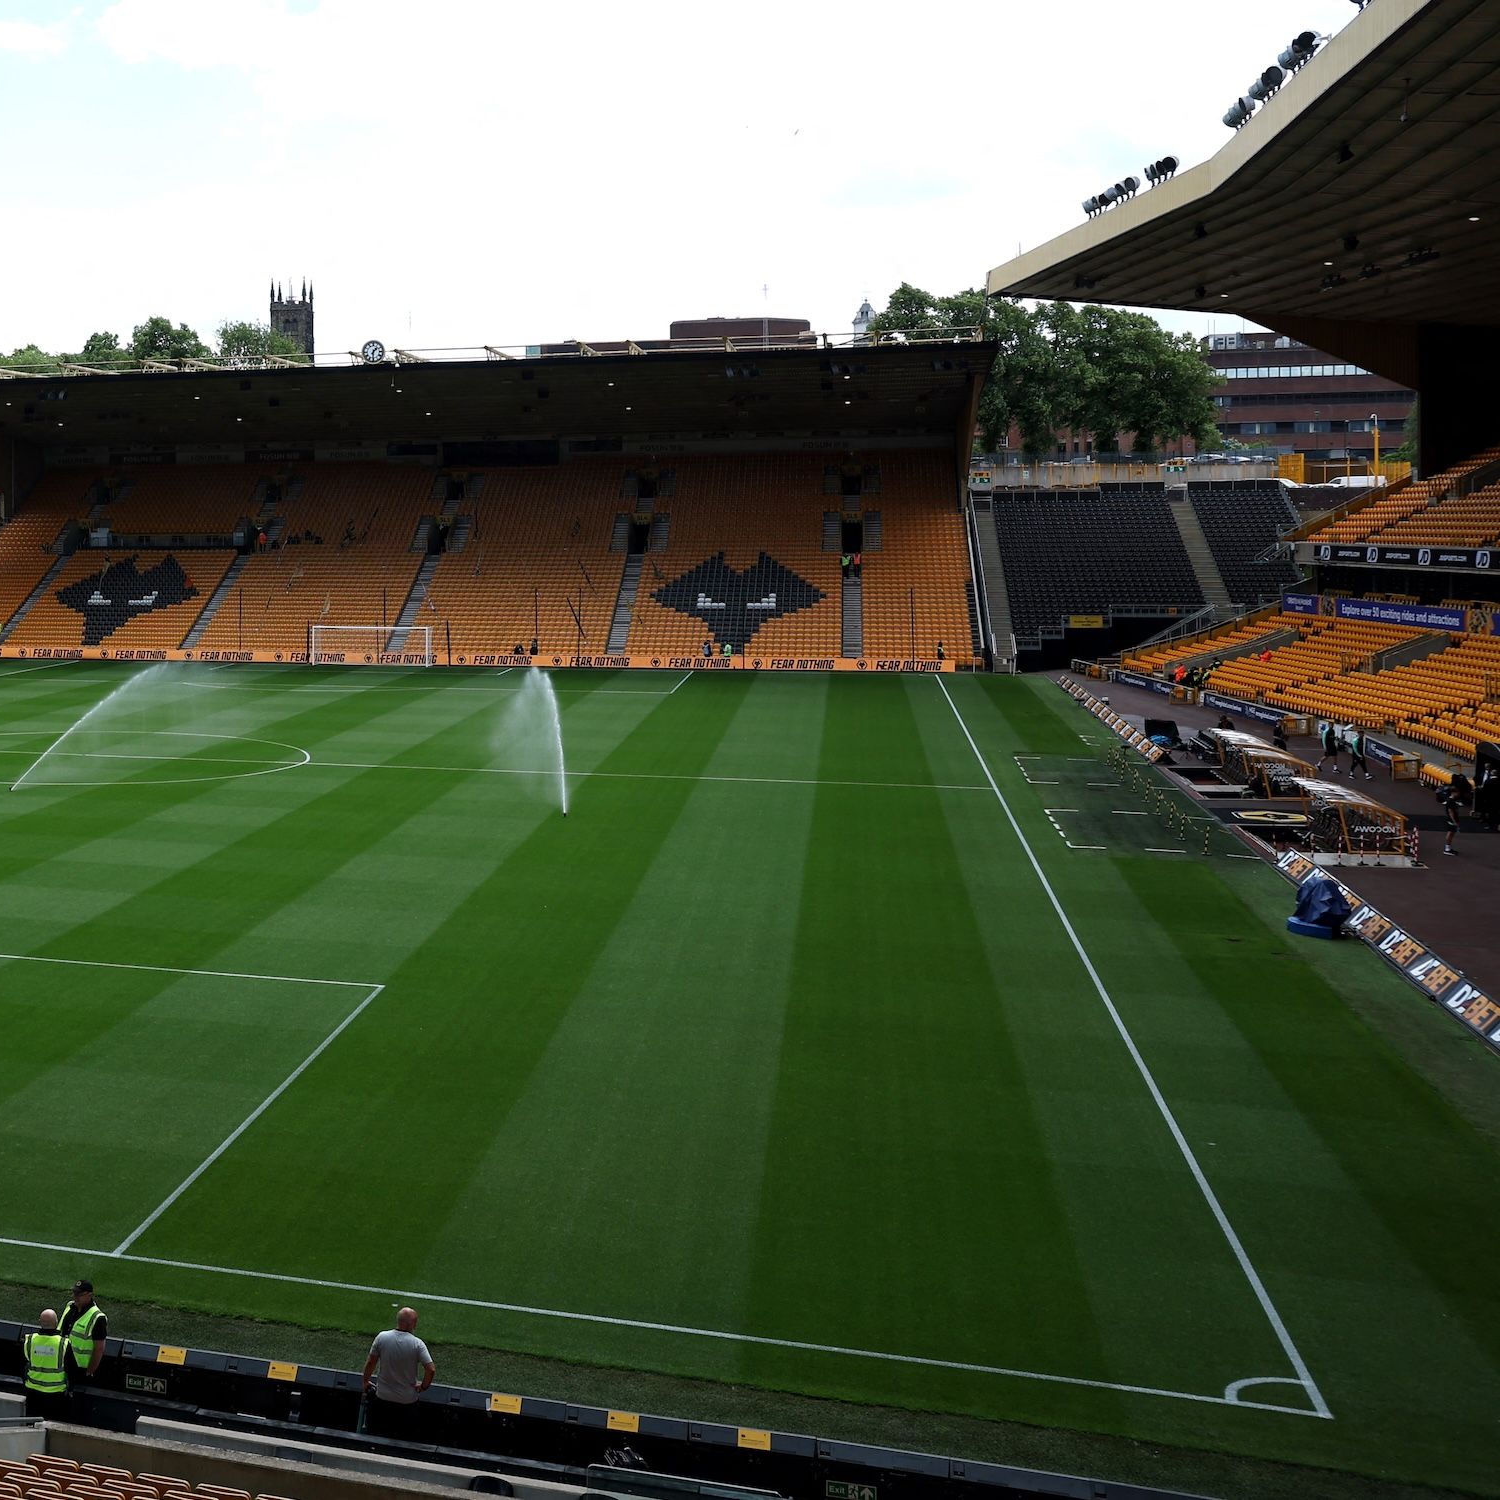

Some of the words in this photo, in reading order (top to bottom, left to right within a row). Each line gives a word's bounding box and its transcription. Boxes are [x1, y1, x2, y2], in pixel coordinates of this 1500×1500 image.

[1341, 604, 1361, 617] Explore
[1361, 607, 1372, 617] over
[1372, 606, 1380, 617] 50
[1380, 608, 1400, 622] exciting
[1401, 610, 1415, 621] rides
[1415, 611, 1427, 622] and
[1427, 613, 1460, 627] attractions
[33, 648, 52, 658] FEAR
[53, 648, 83, 659] NOTHING
[115, 649, 135, 659] FEAR
[136, 650, 167, 660] NOTHING
[200, 651, 221, 661] FEAR
[221, 652, 254, 662] NOTHING
[290, 652, 311, 662] FEAR
[313, 653, 345, 663] NOTHING
[380, 654, 402, 664] FEAR
[403, 654, 437, 665] NOTHING
[474, 655, 496, 665] FEAR
[496, 655, 532, 666] NOTHING
[570, 656, 592, 666] FEAR
[593, 656, 630, 667] NOTHING
[669, 657, 692, 668] FEAR
[693, 658, 731, 668] NOTHING
[771, 659, 794, 669] FEAR
[796, 659, 835, 670] NOTHING
[876, 660, 901, 671] FEAR
[902, 660, 942, 671] NOTHING
[128, 1378, 141, 1386] Exit
[830, 1485, 845, 1494] Exit
